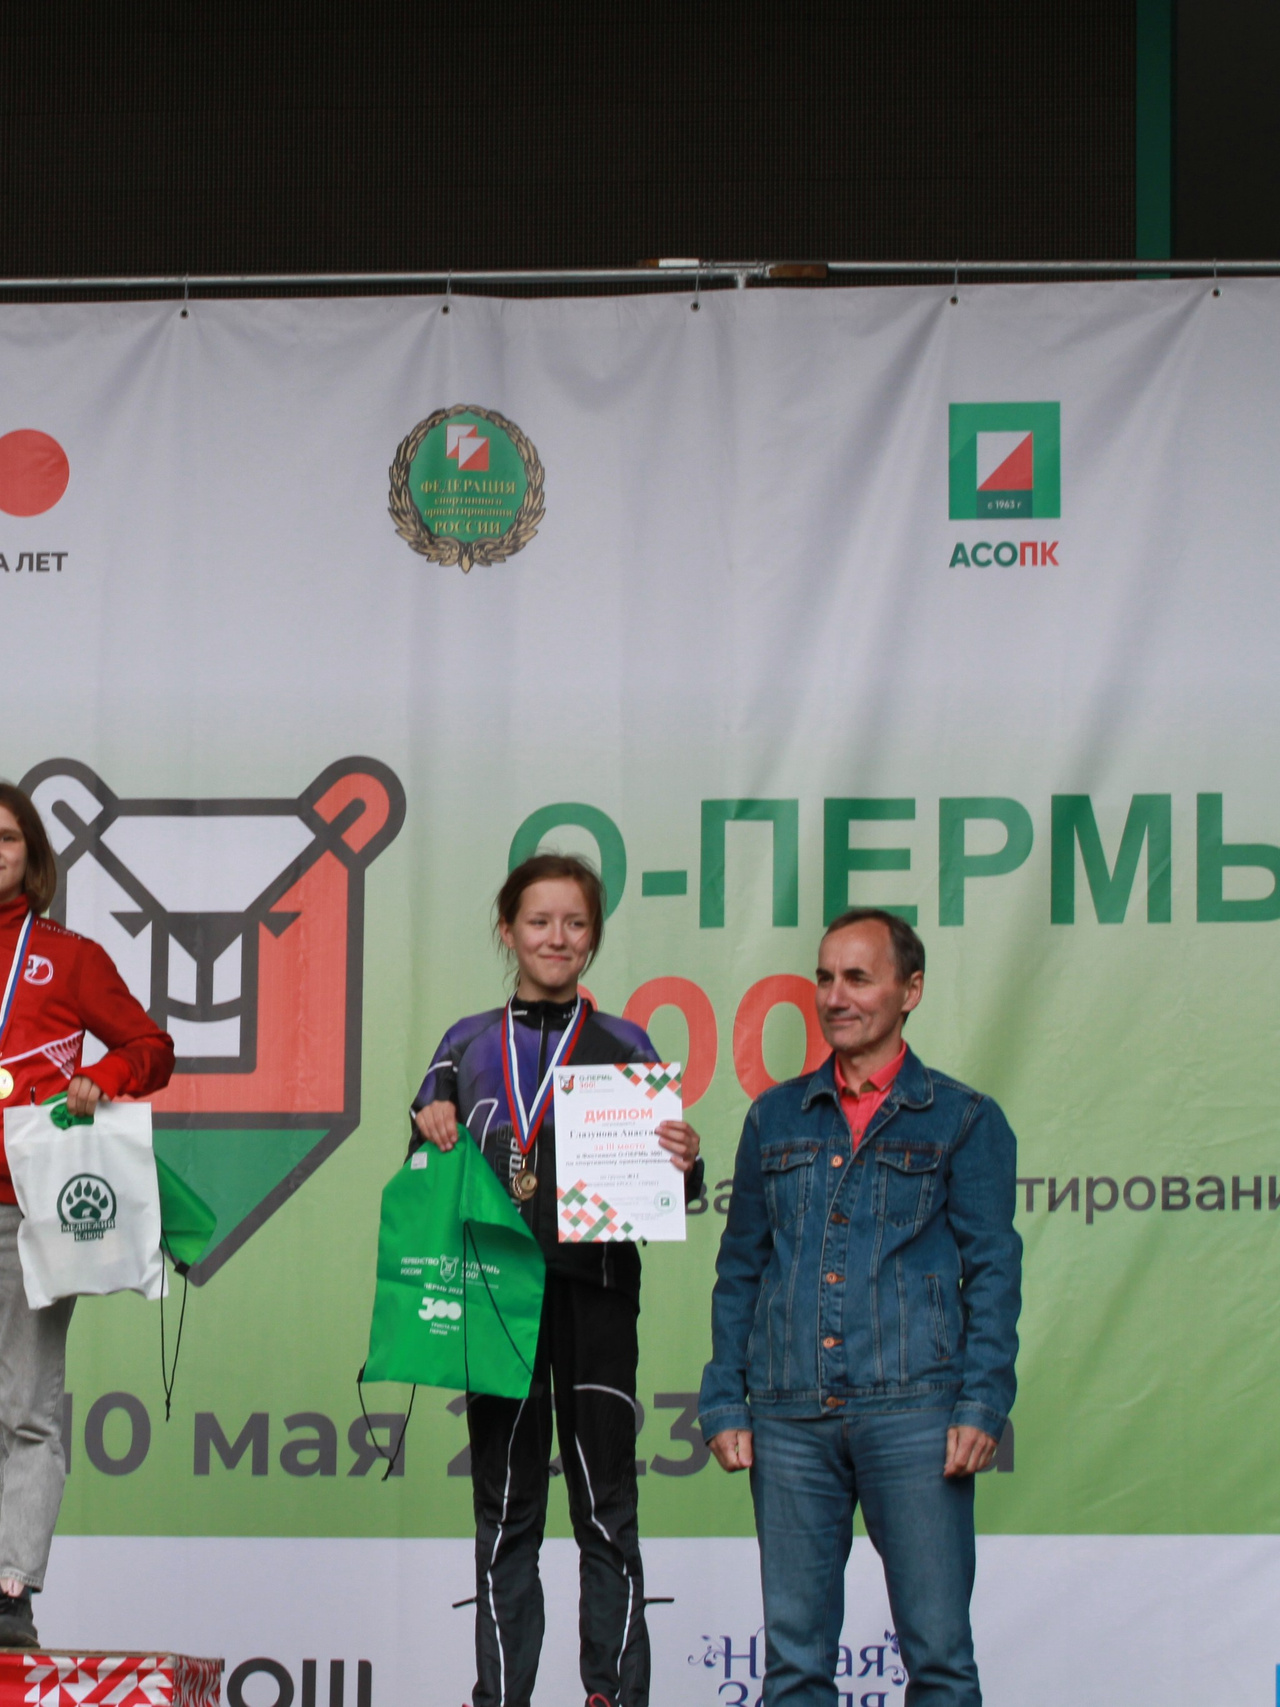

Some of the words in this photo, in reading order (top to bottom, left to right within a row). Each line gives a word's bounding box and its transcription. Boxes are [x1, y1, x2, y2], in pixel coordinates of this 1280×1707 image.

[420, 479, 516, 495] ФЕДЕРАЦИЯ
[995, 500, 1015, 510] 1963
[434, 520, 501, 535] РОССИИ
[15, 552, 68, 572] ЛЕТ
[949, 541, 1060, 568] АСОПК
[578, 974, 834, 1110] 00
[584, 1108, 653, 1124] ДИПЛОМ
[418, 1296, 462, 1321] 300
[193, 1411, 406, 1478] мая
[719, 1635, 889, 1679] Ная
